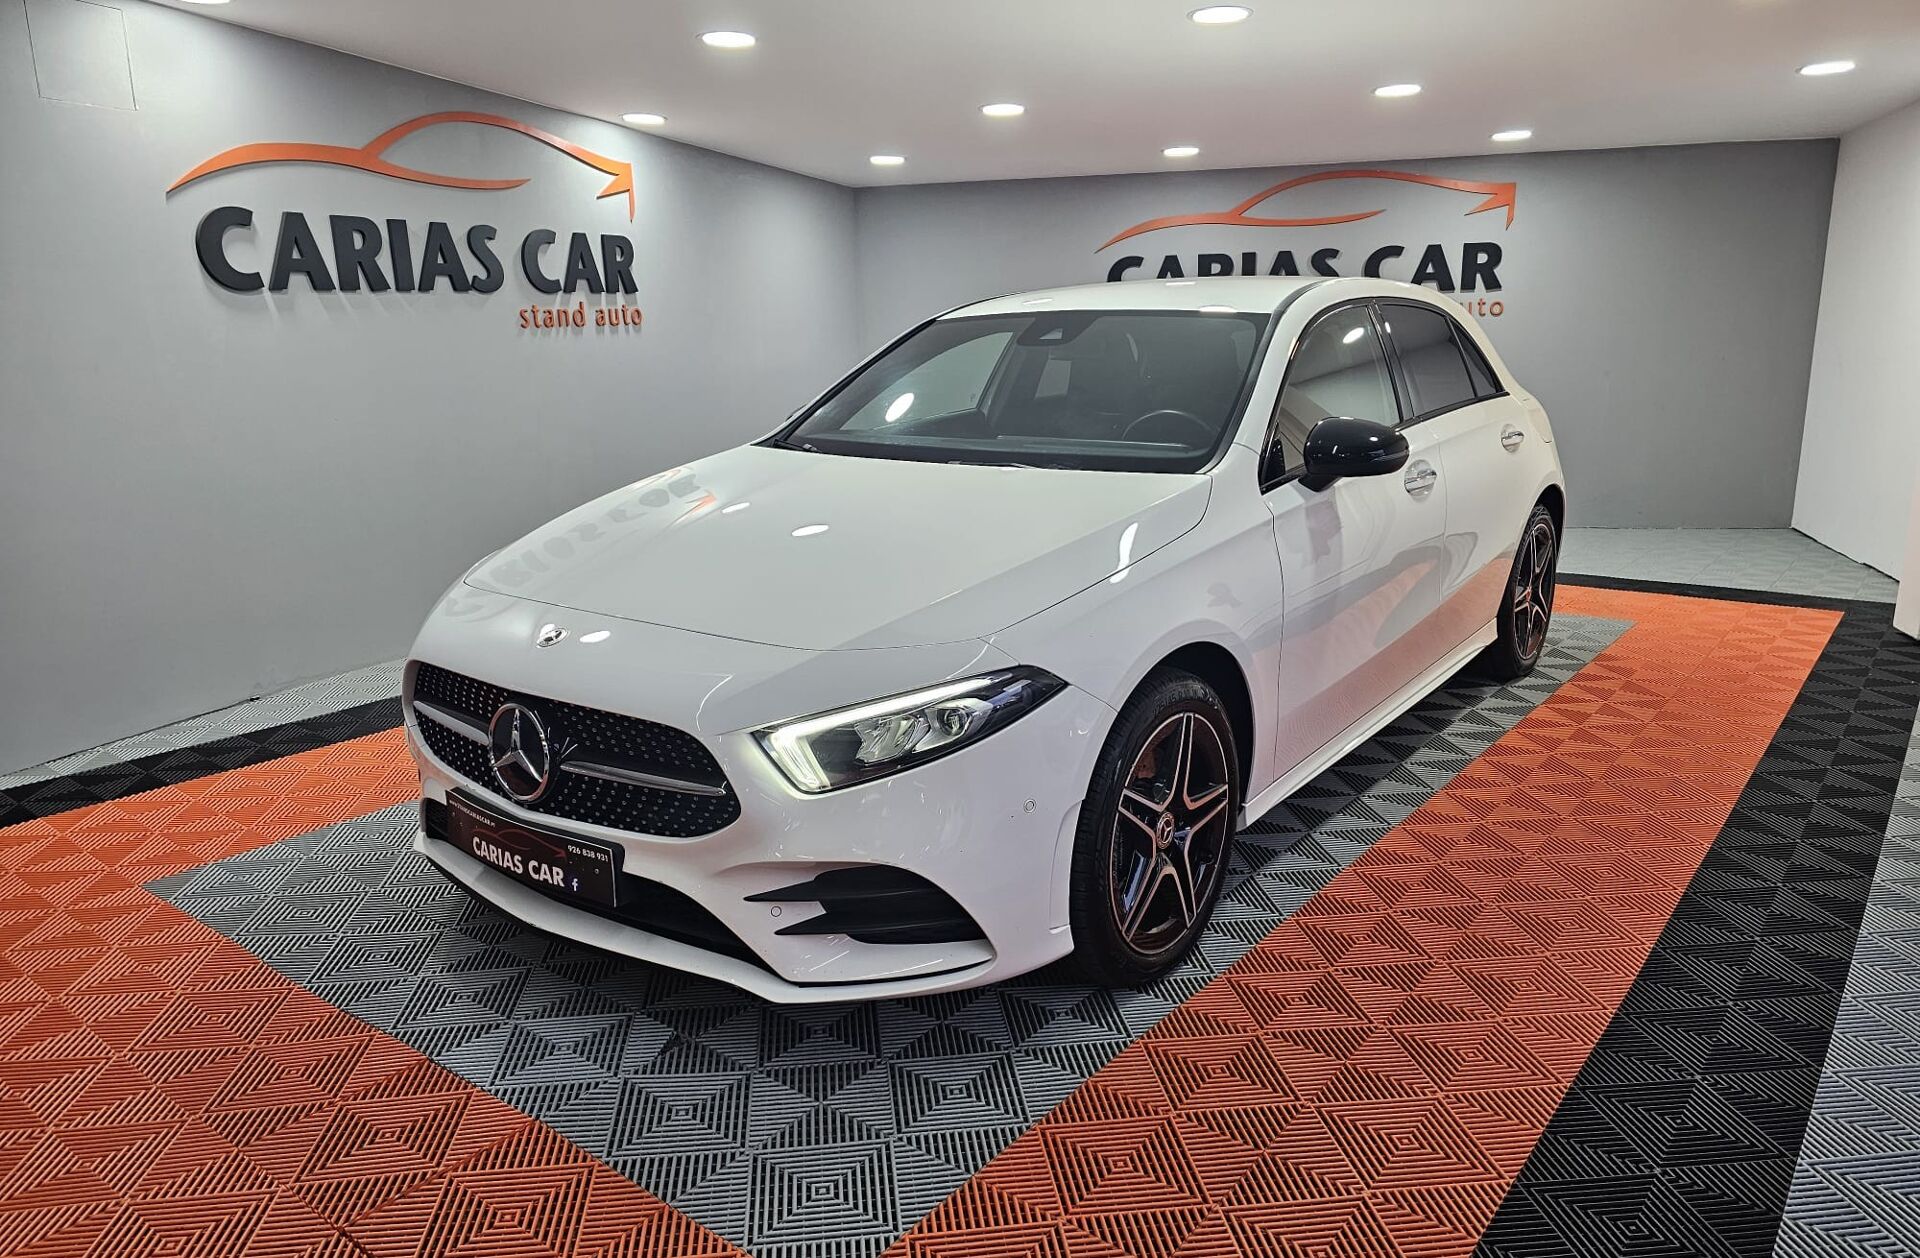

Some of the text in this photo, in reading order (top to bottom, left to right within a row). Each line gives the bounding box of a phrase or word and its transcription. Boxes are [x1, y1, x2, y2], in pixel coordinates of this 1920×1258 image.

[196, 206, 639, 294] CARIAS CAR
[1363, 241, 1503, 294] CAR
[519, 302, 642, 328] stand auto
[472, 836, 565, 887] CARIAS CAR
[567, 844, 609, 862] 926 838 931
